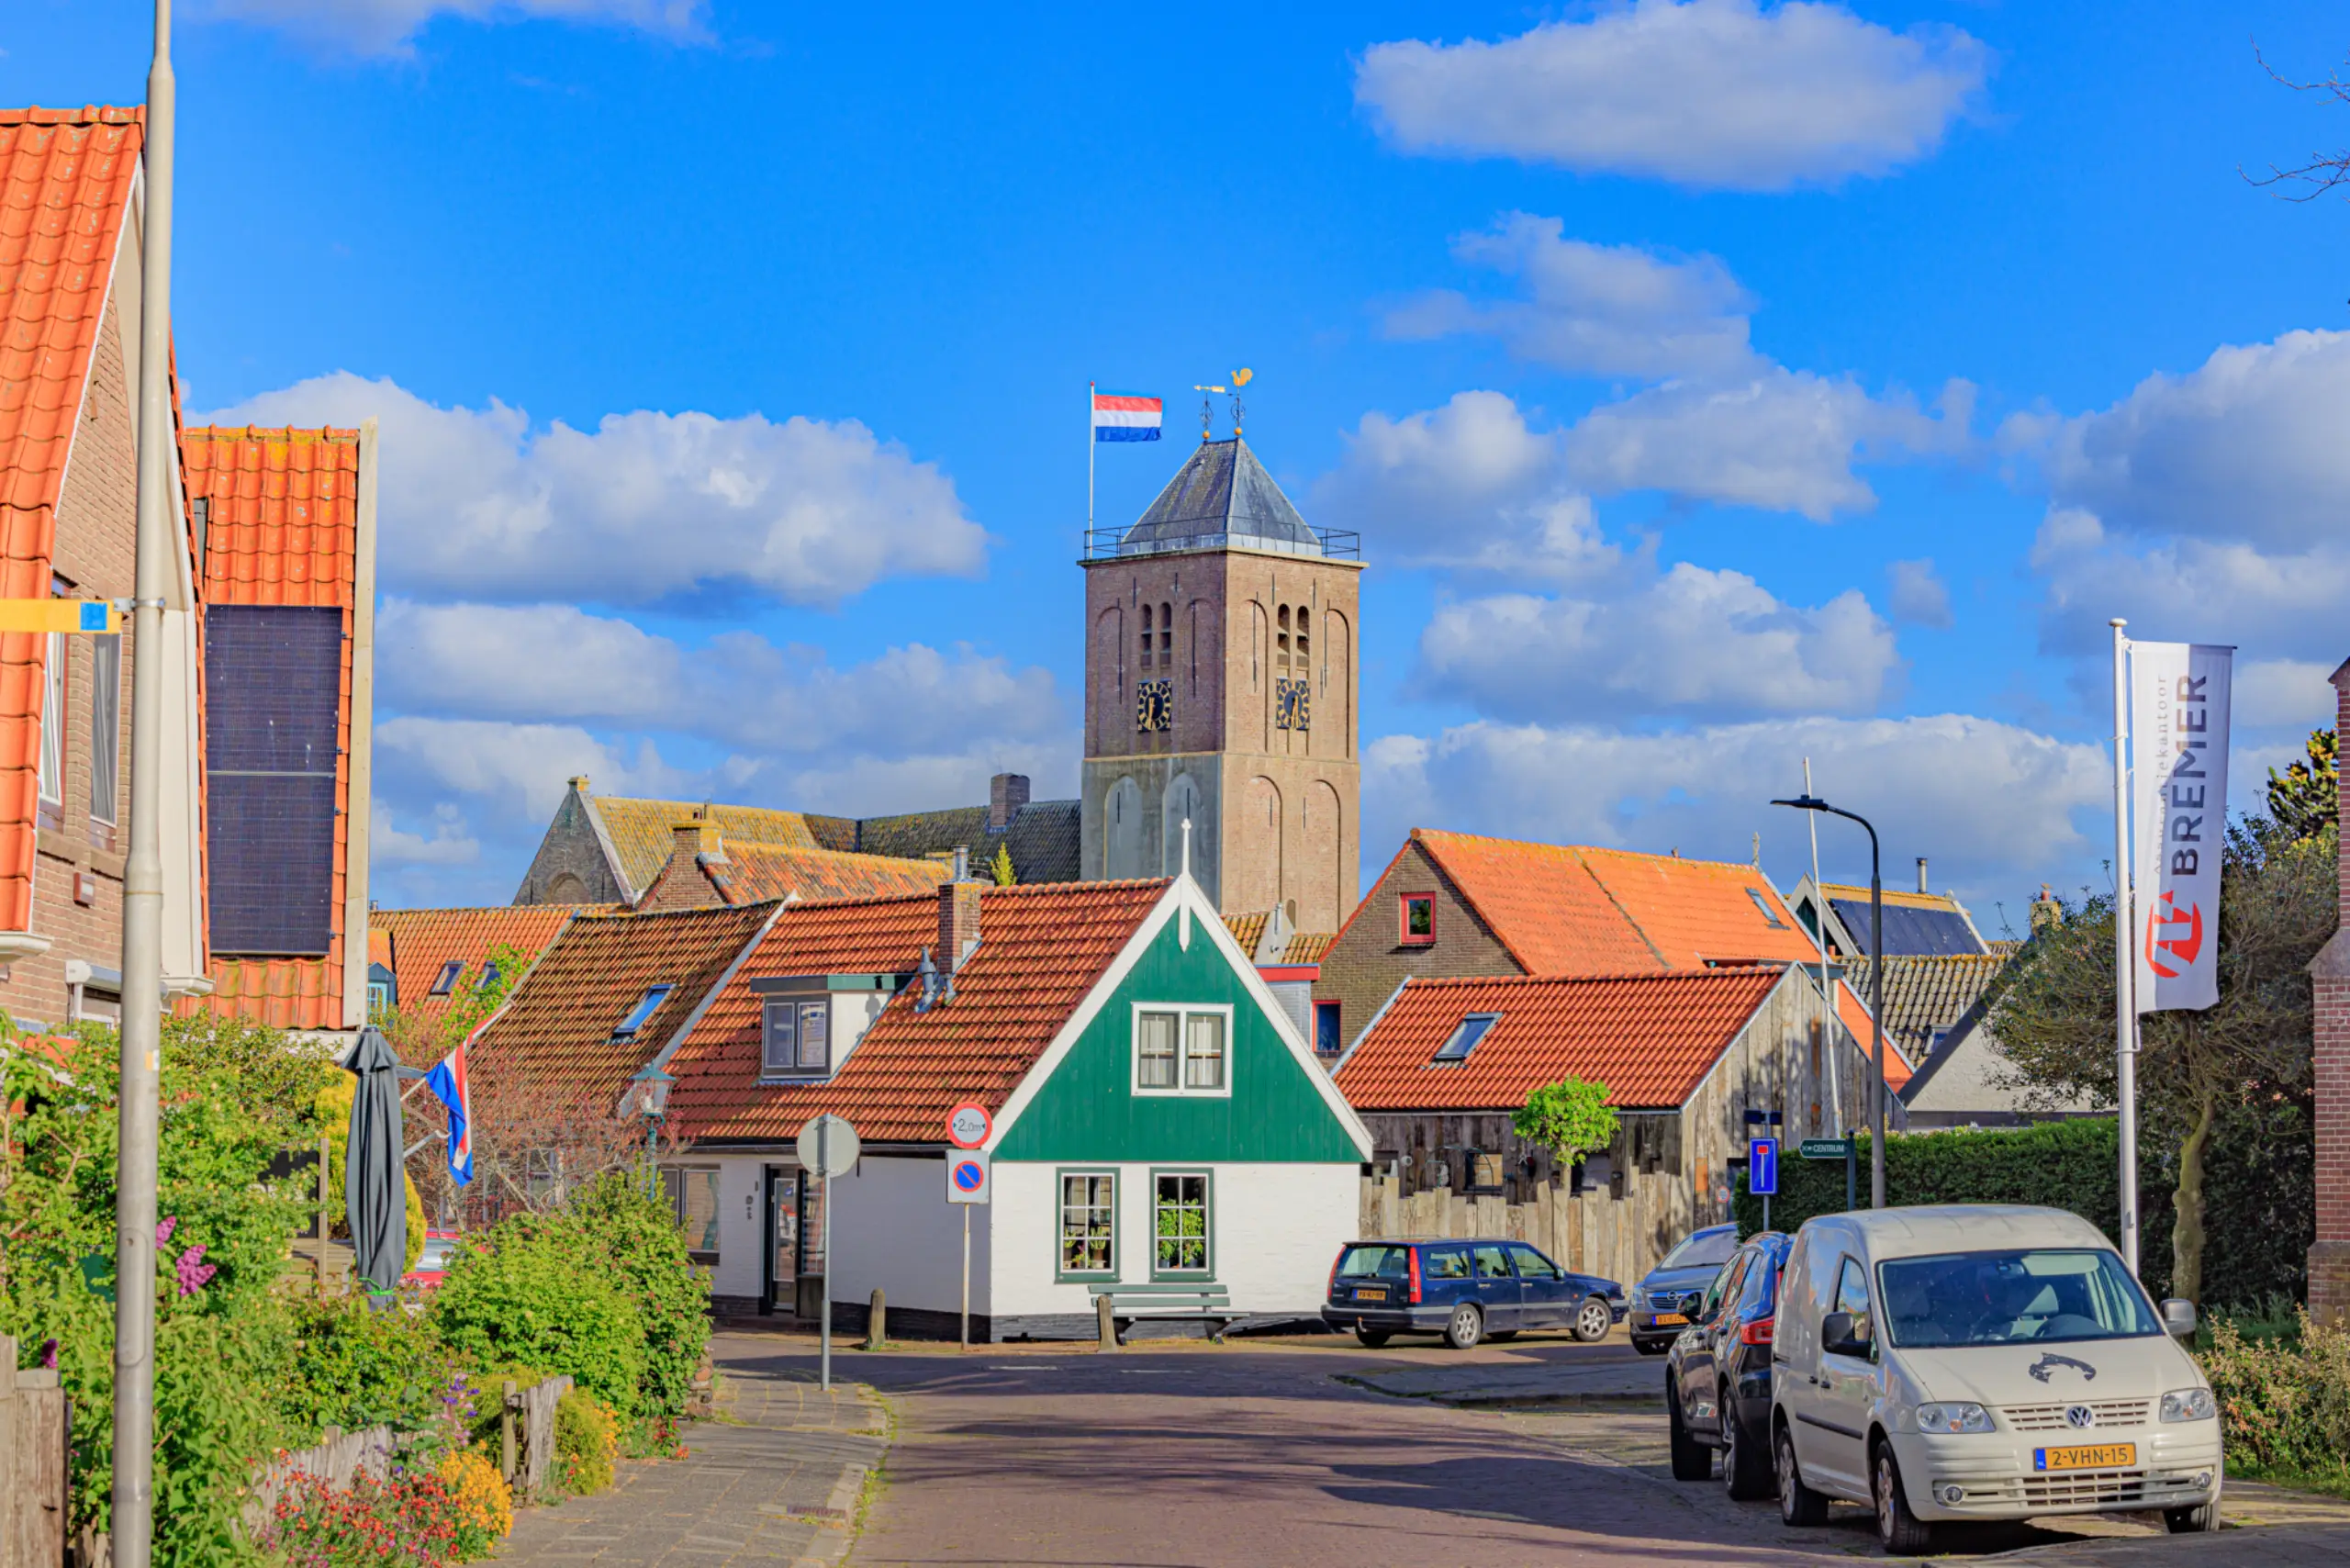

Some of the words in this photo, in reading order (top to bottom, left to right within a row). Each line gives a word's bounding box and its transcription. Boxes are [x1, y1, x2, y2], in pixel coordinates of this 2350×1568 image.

[2171, 675, 2207, 876] BREMER
[1813, 1144, 1844, 1153] CENTRUM
[2052, 1447, 2128, 1466] 2-VHN-15
